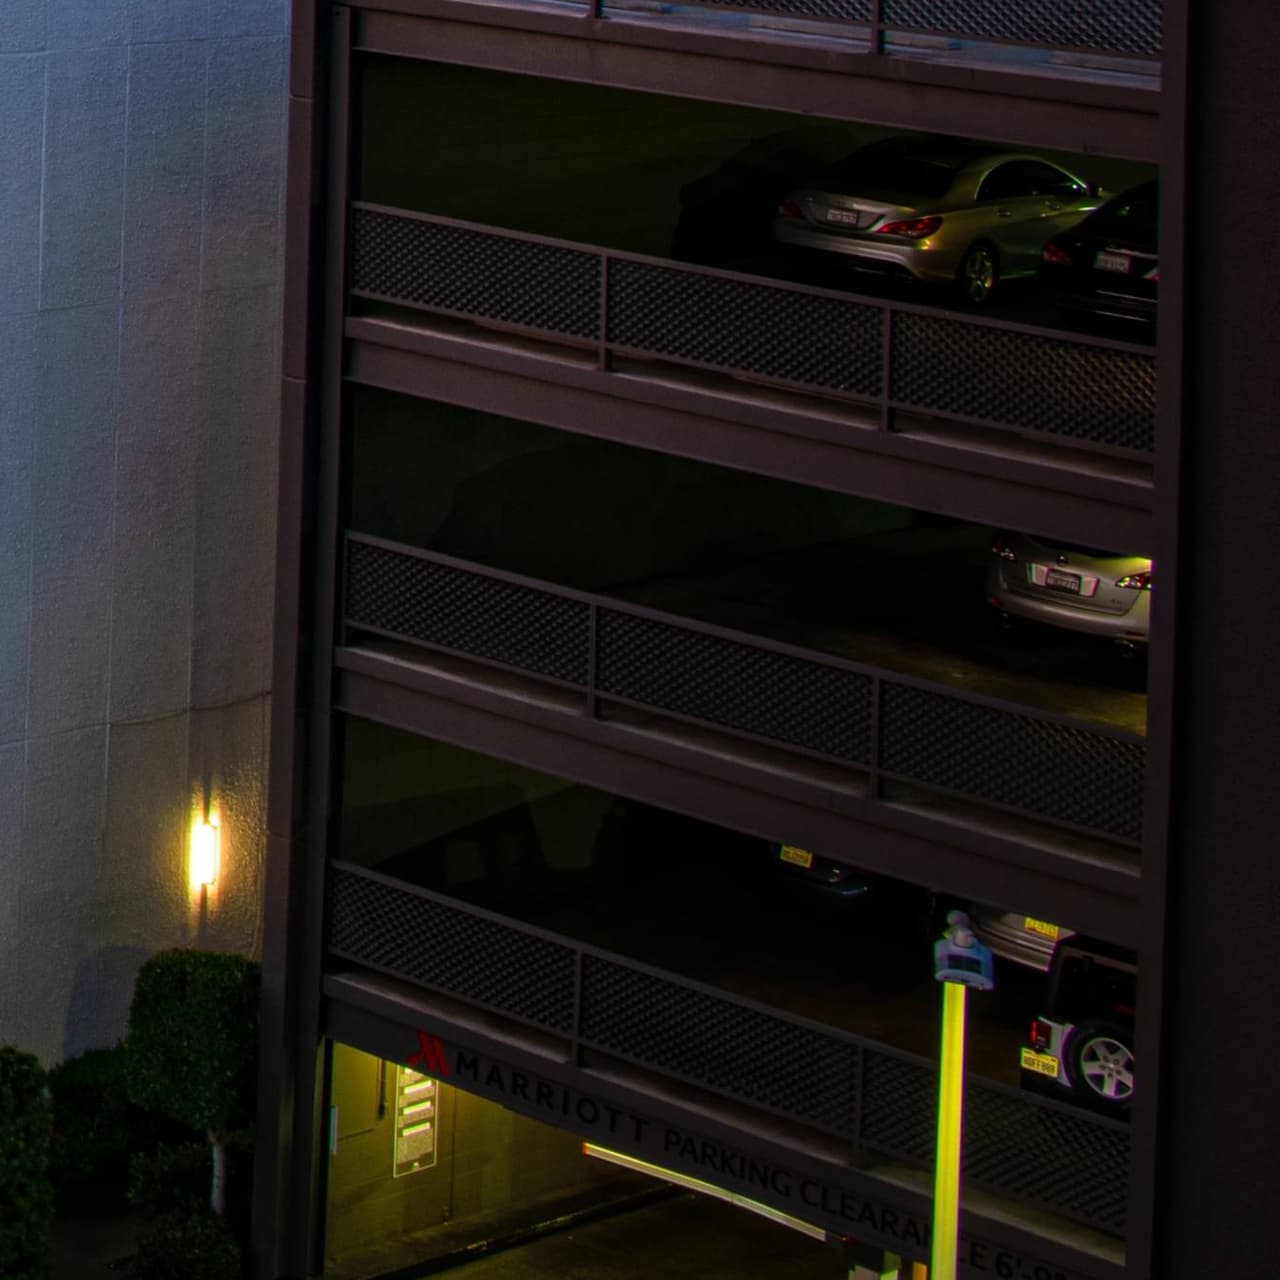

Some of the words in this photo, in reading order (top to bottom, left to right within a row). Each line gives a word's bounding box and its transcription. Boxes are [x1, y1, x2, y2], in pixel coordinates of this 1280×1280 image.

[455, 1051, 650, 1141] MARRIOTT
[664, 1128, 792, 1197] PARKING
[799, 1178, 986, 1271] CLEARAE
